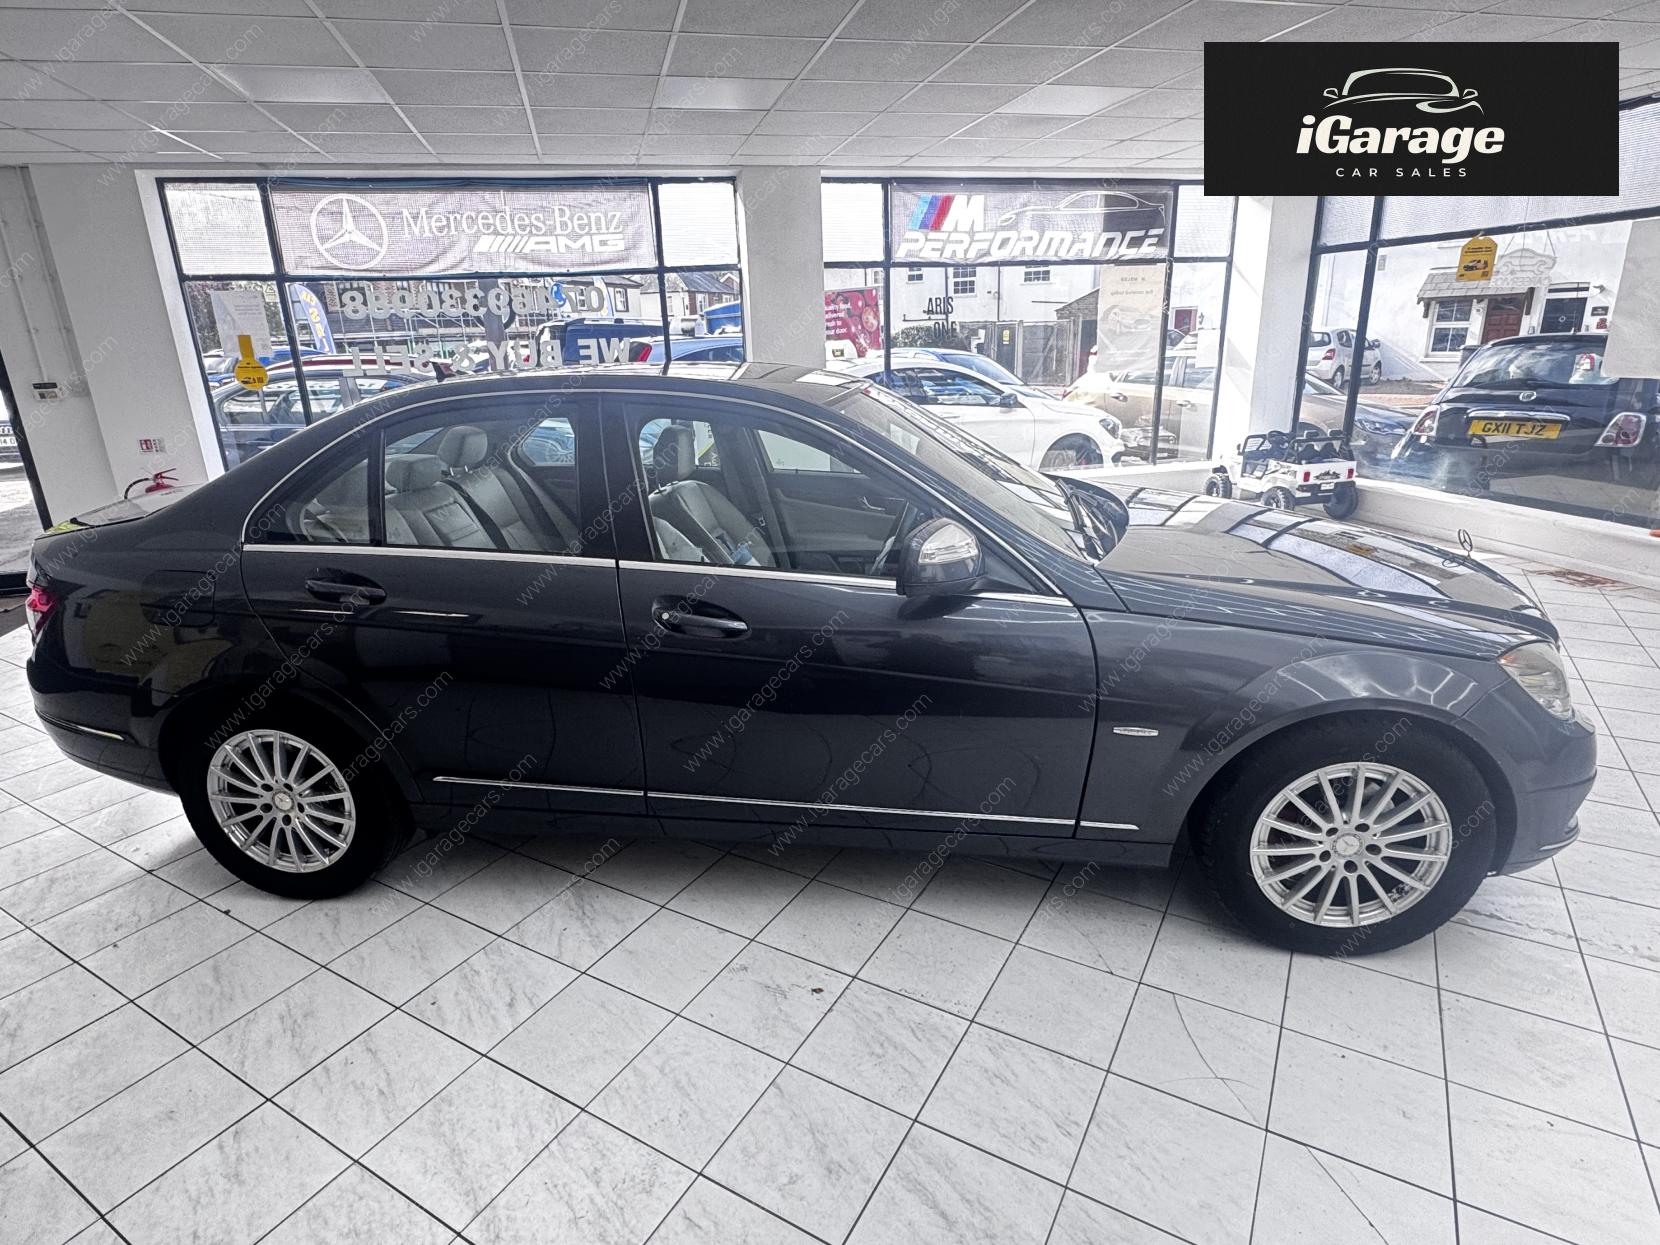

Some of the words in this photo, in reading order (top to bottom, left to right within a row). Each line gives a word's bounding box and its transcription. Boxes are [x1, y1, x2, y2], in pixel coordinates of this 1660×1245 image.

[401, 206, 623, 238] Mercedes-Benz
[895, 228, 1165, 259] PERFORMANCE
[927, 296, 954, 315] ARIS
[1516, 424, 1546, 436] TJZ
